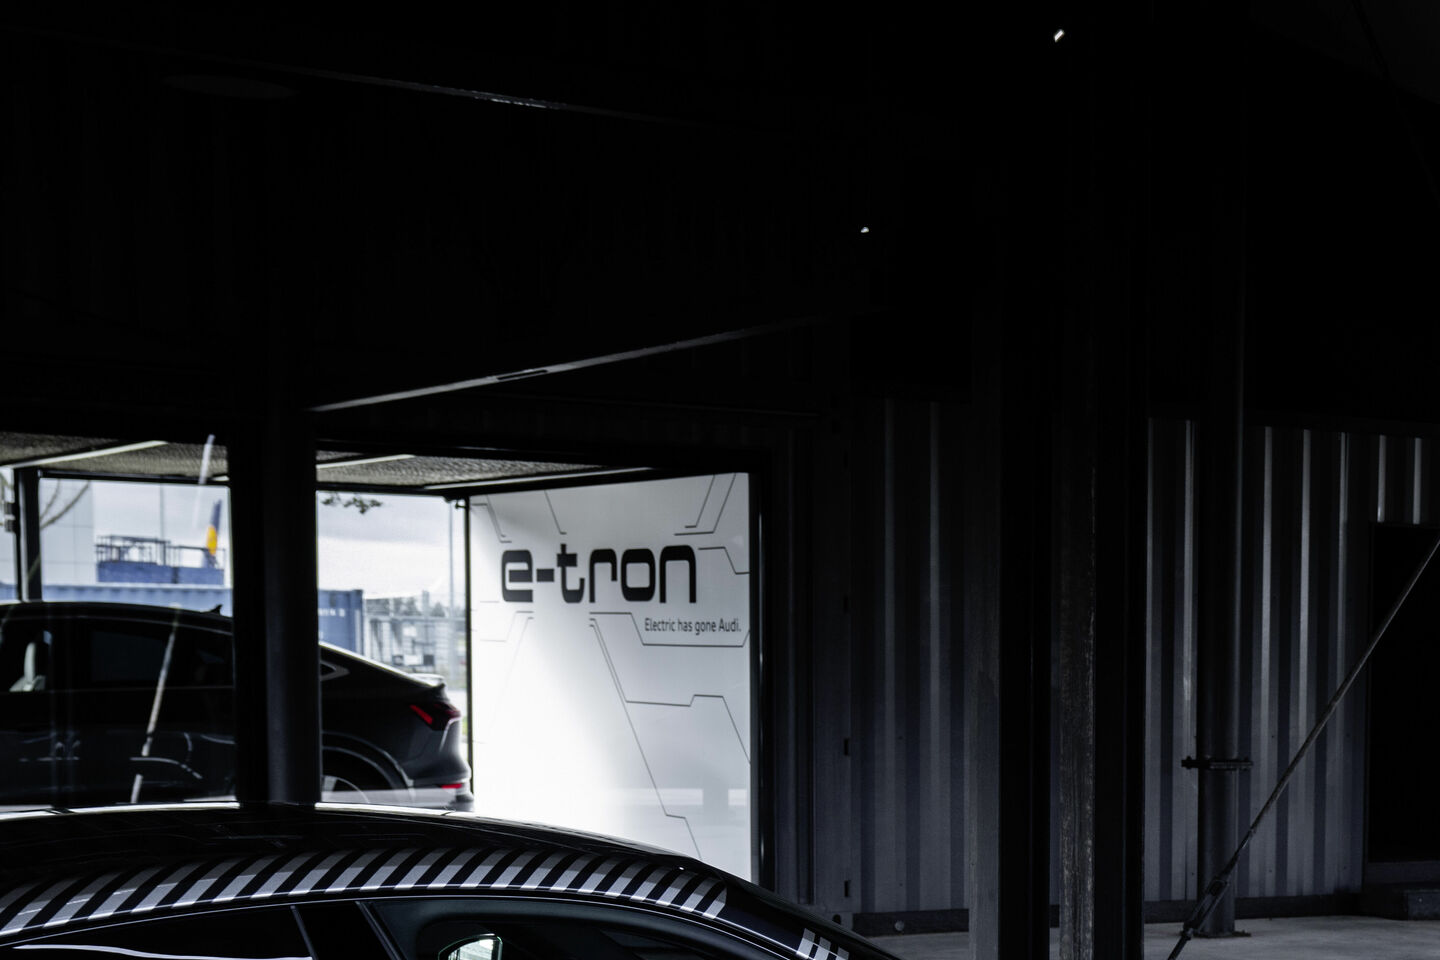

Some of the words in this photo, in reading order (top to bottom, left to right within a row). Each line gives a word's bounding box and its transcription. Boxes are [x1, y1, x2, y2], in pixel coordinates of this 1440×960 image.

[501, 543, 697, 604] e-tron
[644, 617, 675, 632] Electric
[678, 618, 693, 632] has
[695, 620, 717, 636] gone
[718, 617, 742, 632] Audi.
